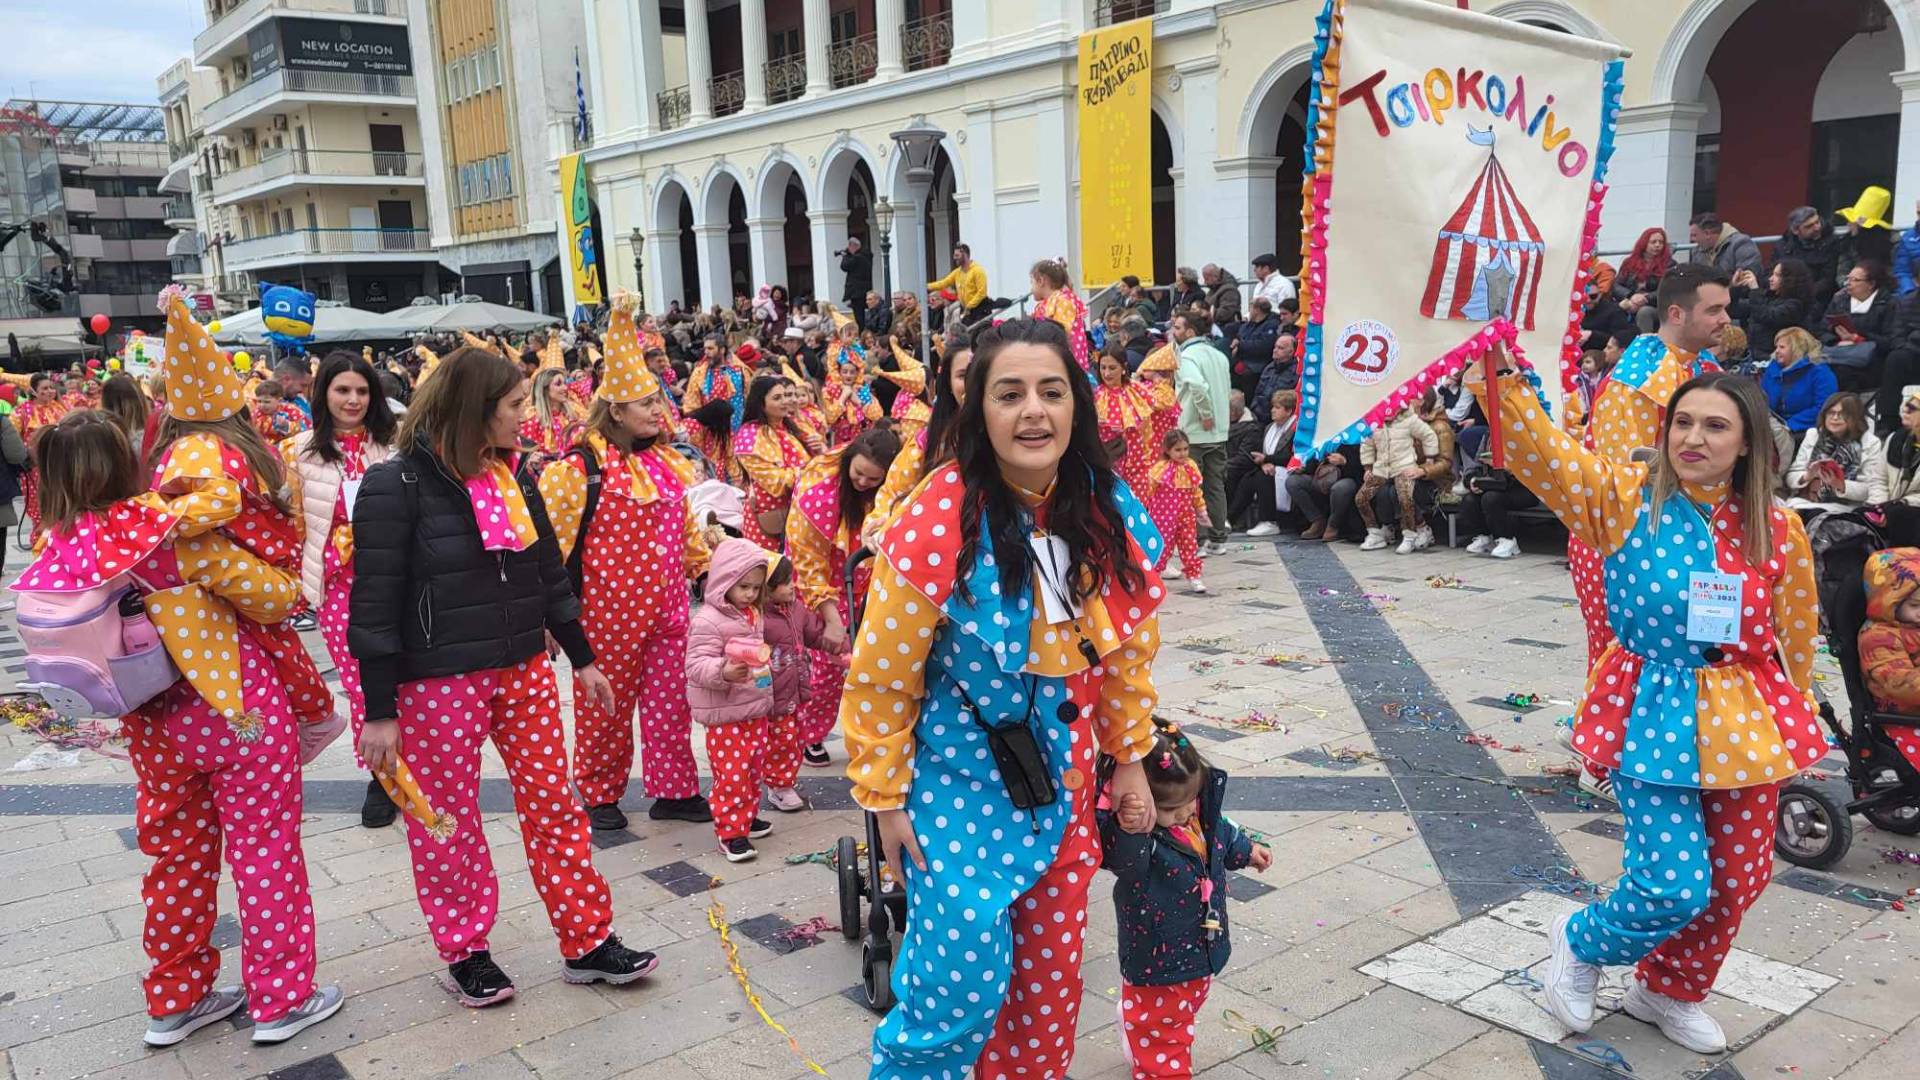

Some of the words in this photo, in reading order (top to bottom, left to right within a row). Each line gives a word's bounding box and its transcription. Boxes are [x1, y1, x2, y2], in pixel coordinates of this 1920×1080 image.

[301, 40, 330, 51] NEW
[334, 42, 393, 55] LOCATION
[1341, 333, 1389, 373] 23
